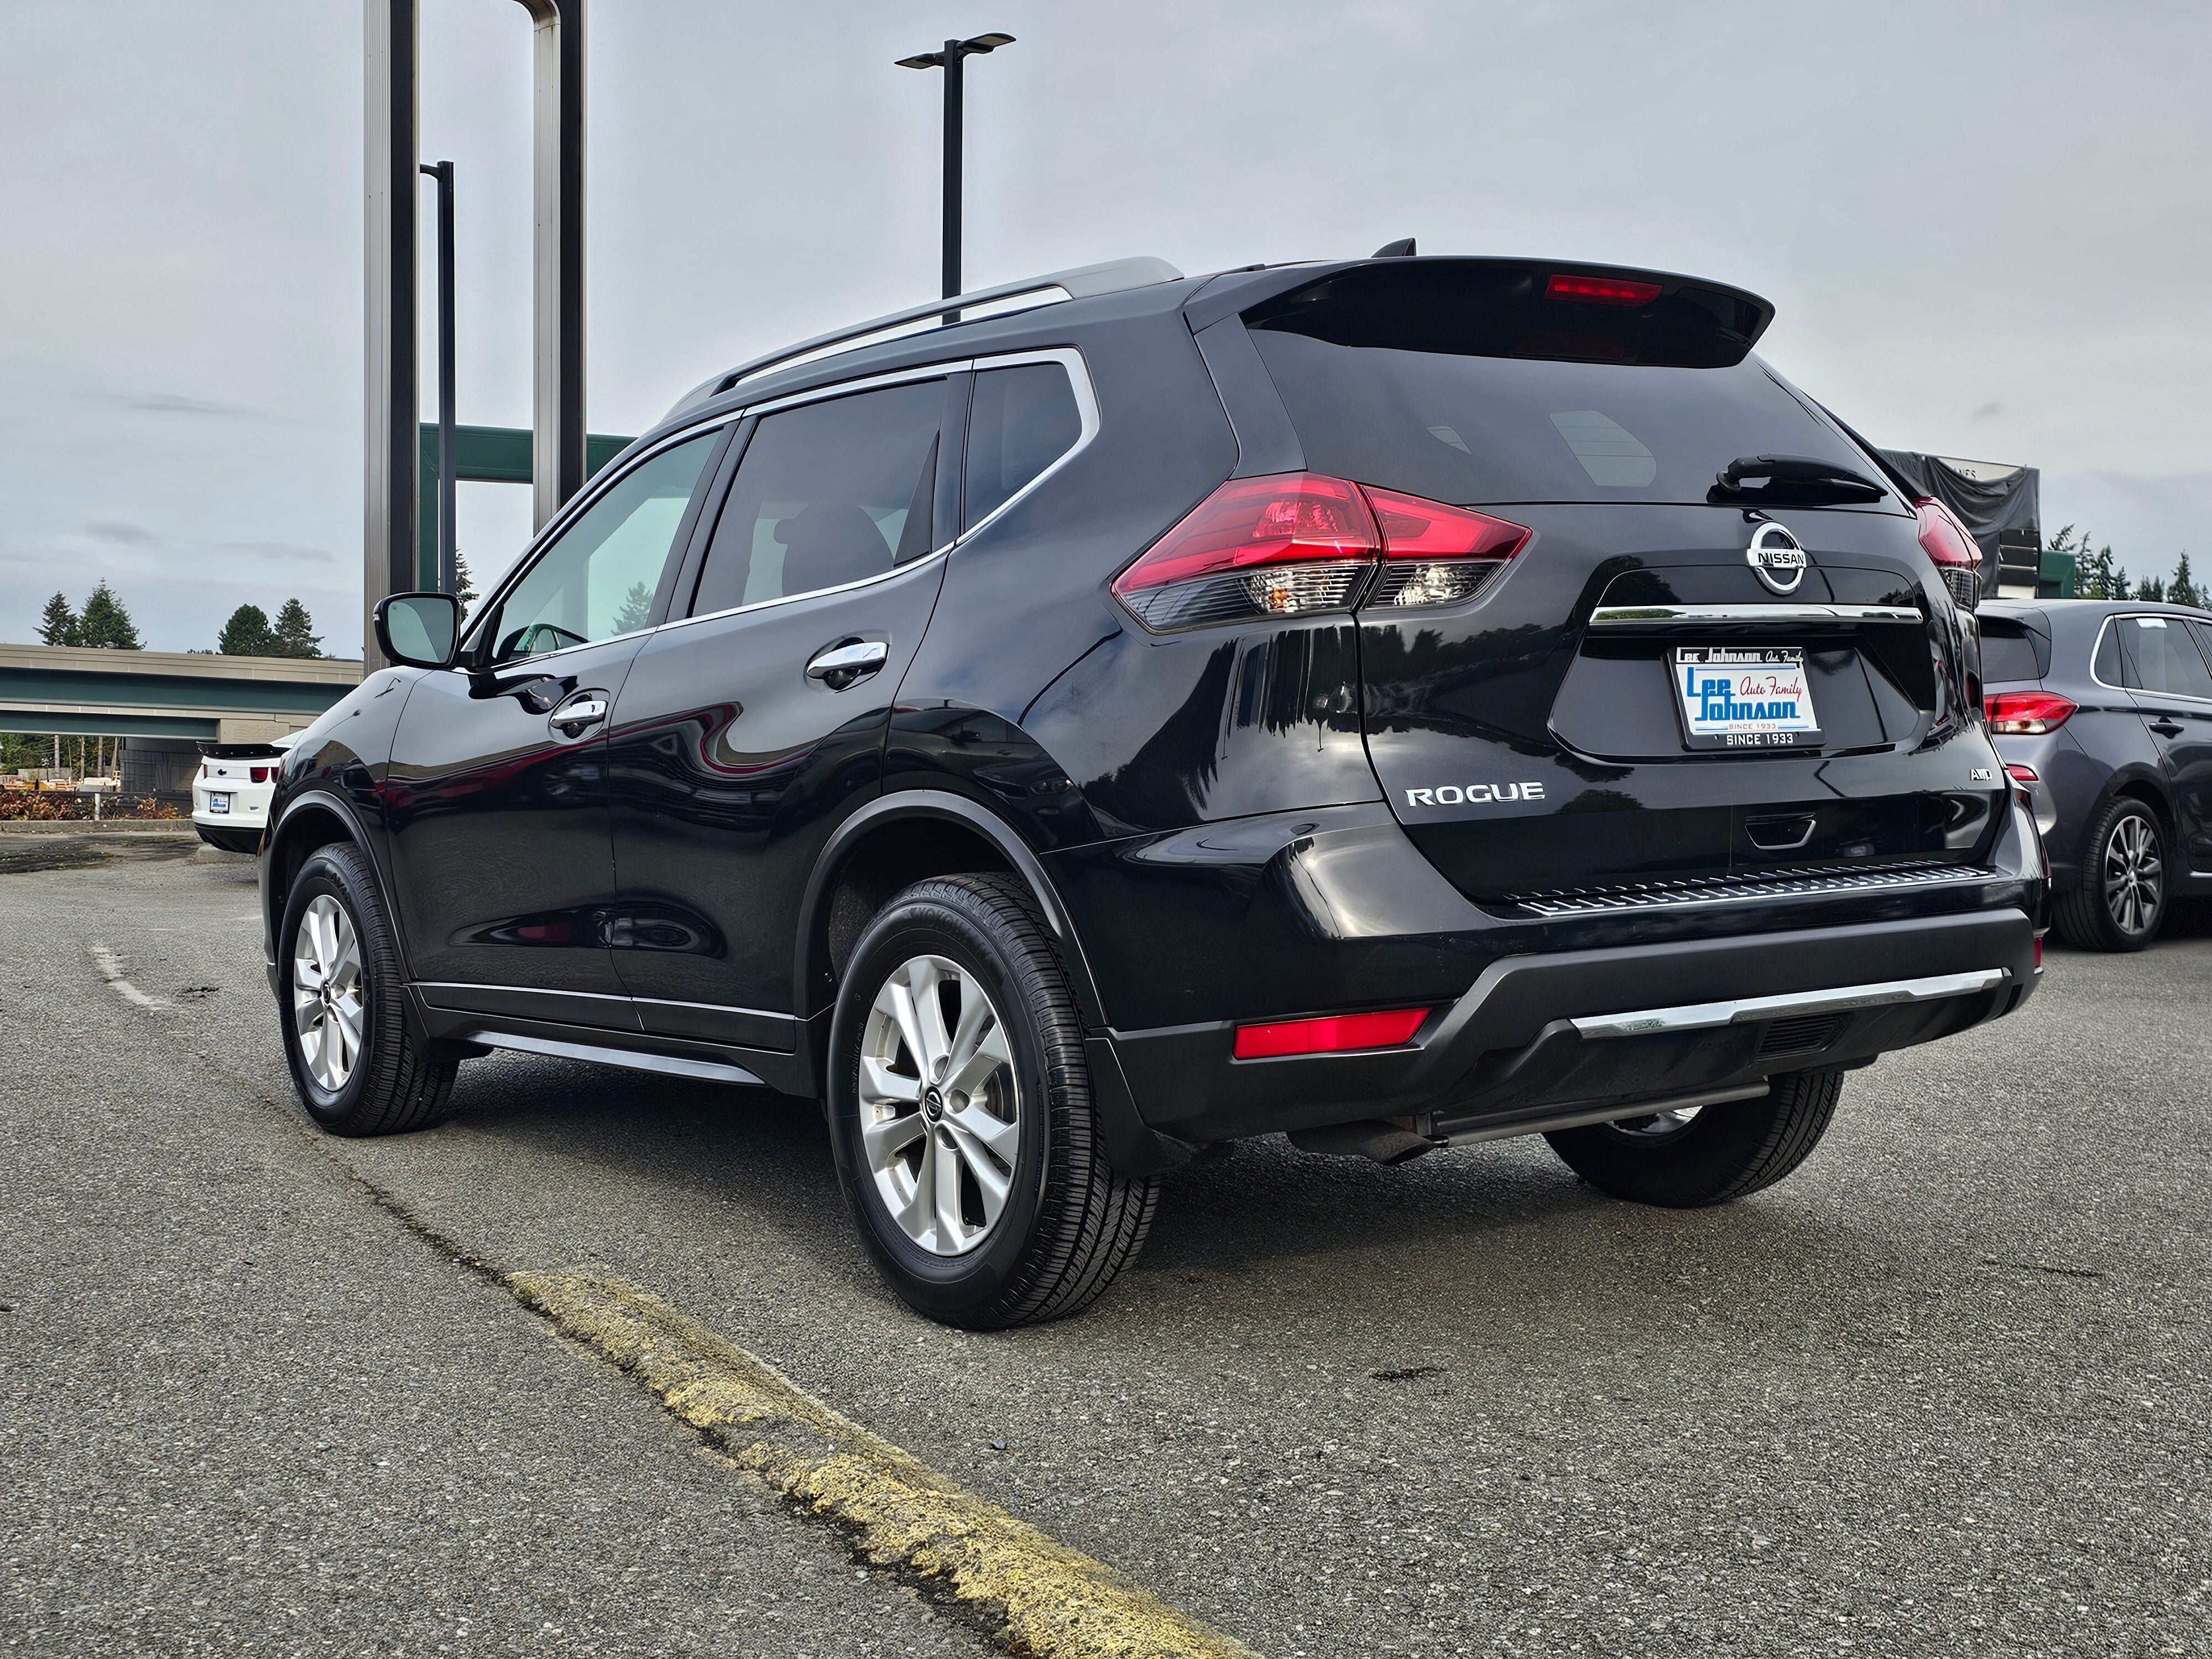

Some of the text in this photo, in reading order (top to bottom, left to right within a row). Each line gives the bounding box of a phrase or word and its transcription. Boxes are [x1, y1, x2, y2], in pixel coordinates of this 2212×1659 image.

[1758, 552, 1804, 565] NISSAN
[1704, 646, 1763, 663] Johnson
[1687, 666, 1736, 697] Lee
[1740, 676, 1803, 702] Auto Family
[1694, 690, 1801, 721] Johnson
[1726, 733, 1793, 745] SINCE 1933
[1405, 781, 1546, 807] ROGUE
